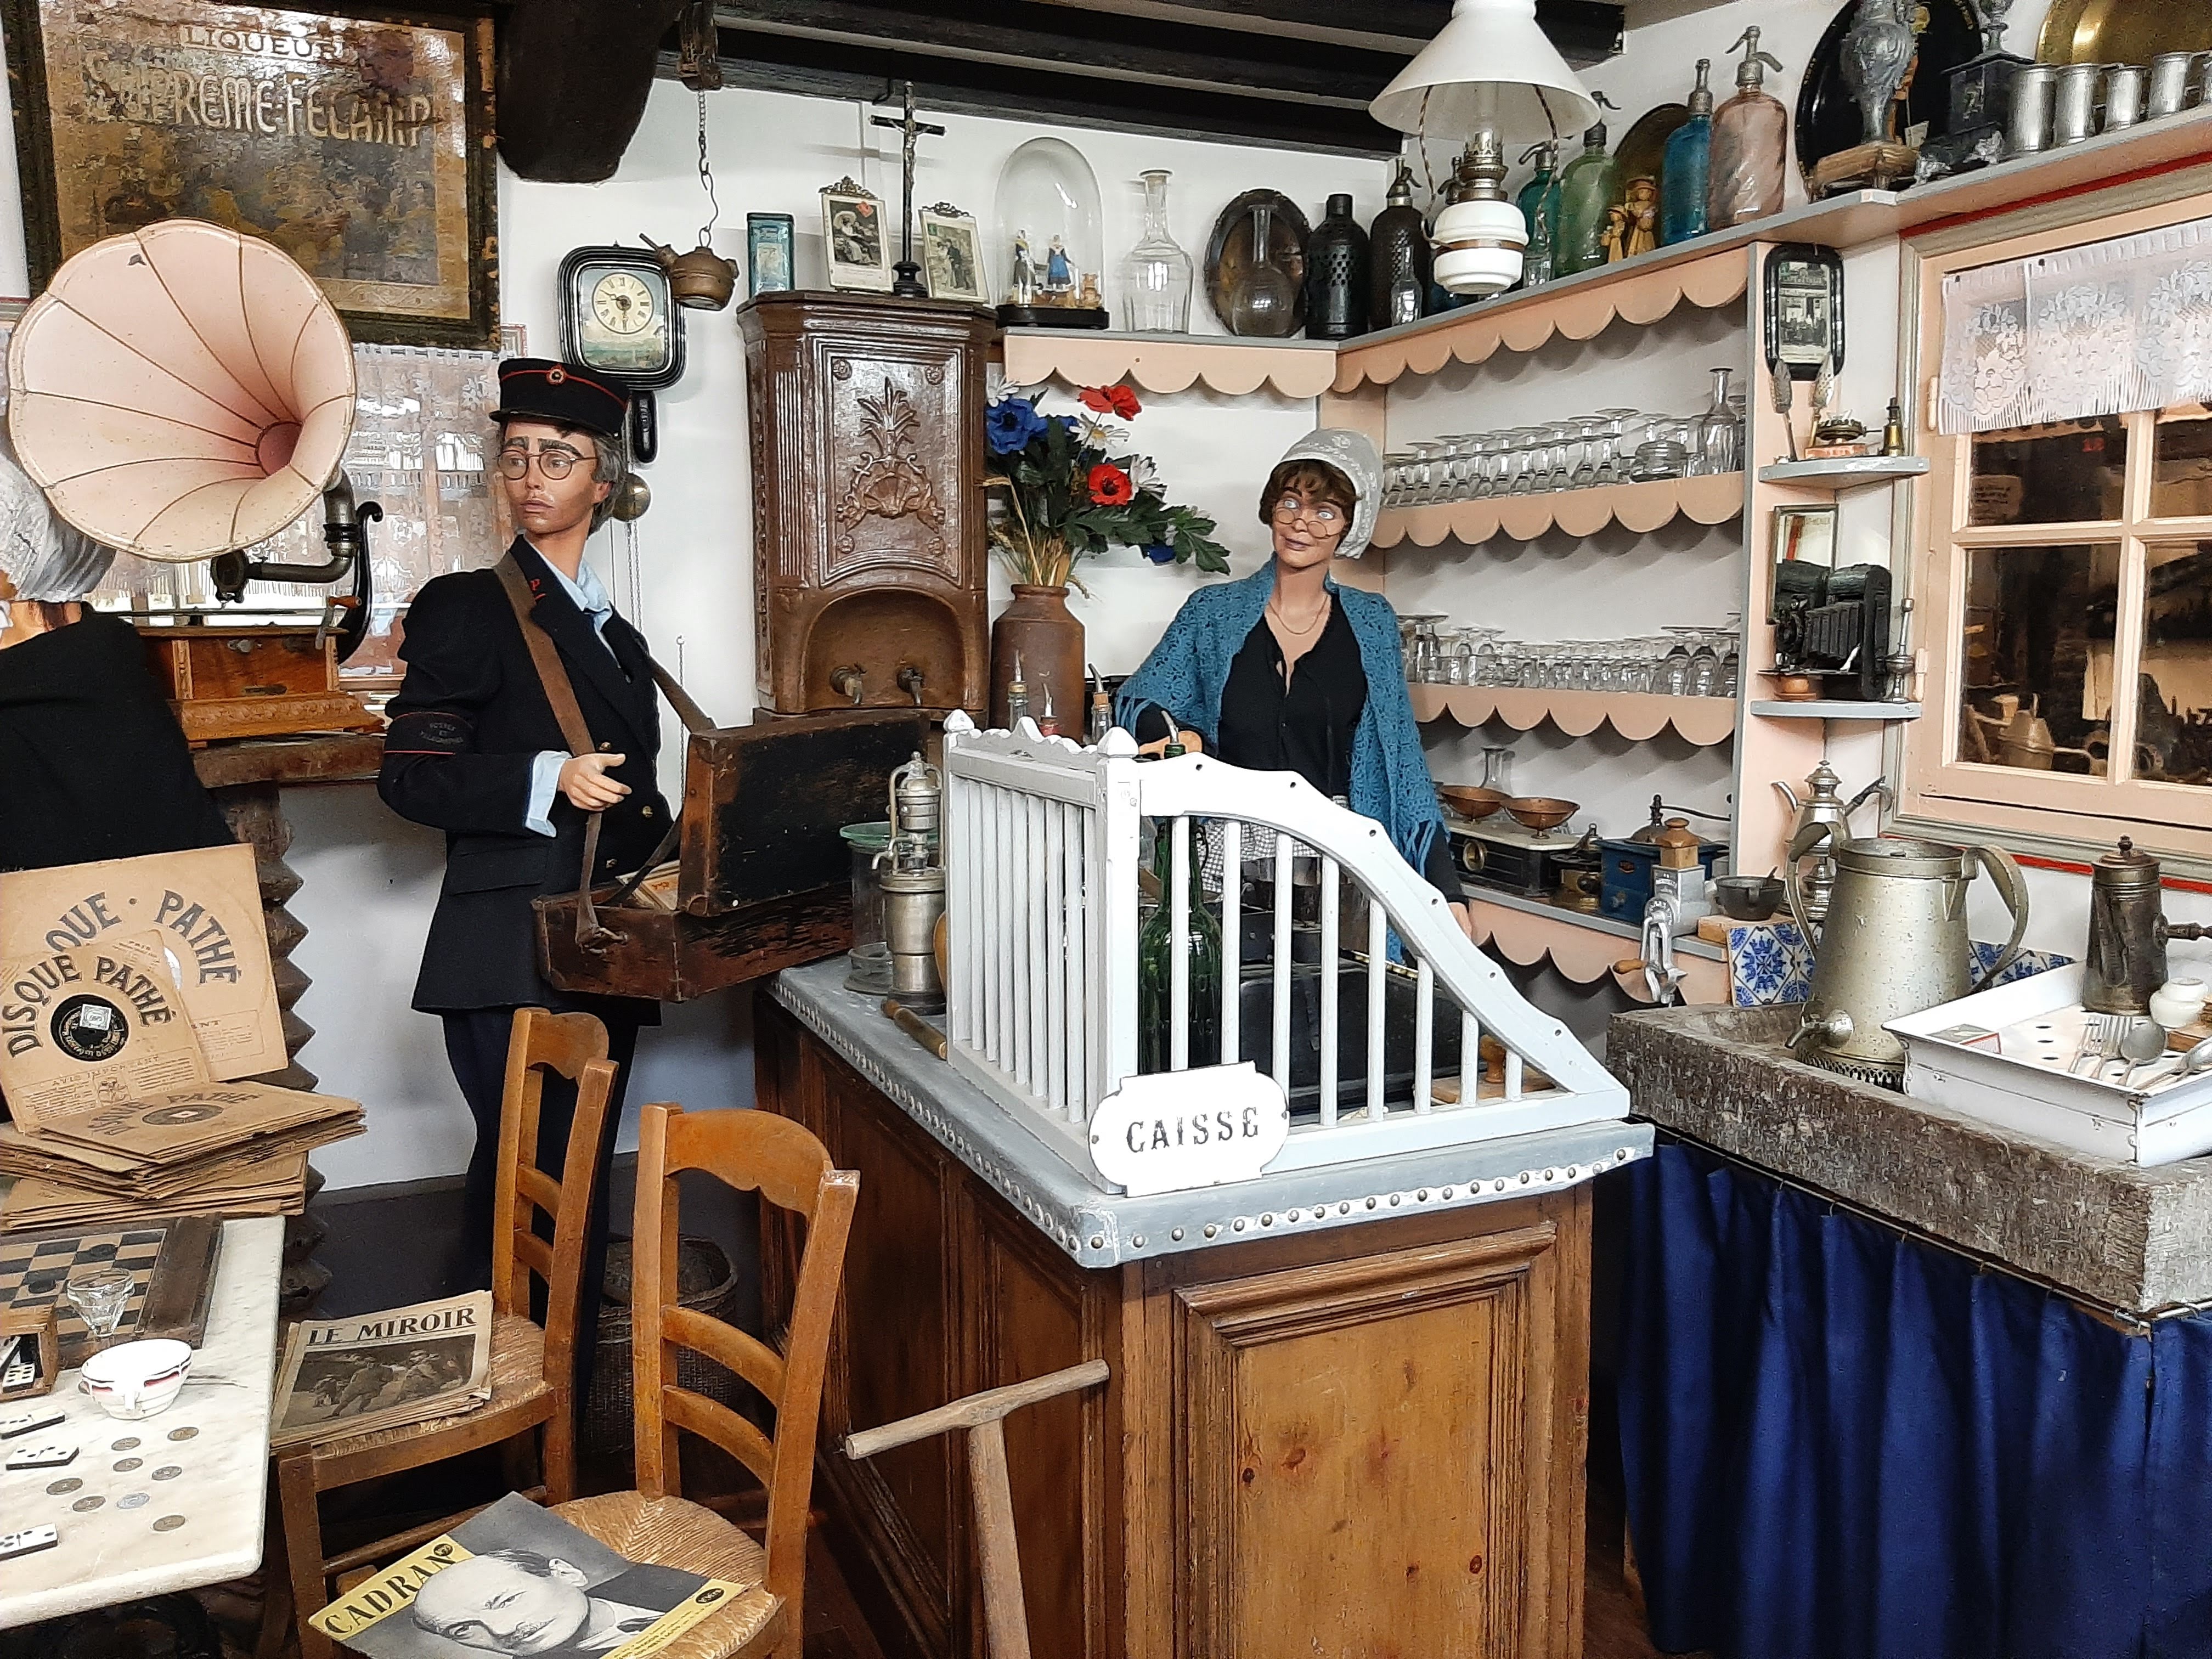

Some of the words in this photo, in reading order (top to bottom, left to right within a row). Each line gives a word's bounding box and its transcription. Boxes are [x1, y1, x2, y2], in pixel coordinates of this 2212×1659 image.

[187, 27, 340, 57] LIQUEUR
[154, 889, 242, 984] PATHÉ
[1, 955, 82, 1058] DISQUE
[94, 956, 177, 1027] PATHÉ
[1126, 1106, 1259, 1153] CAISSE
[308, 1328, 343, 1344] LE
[357, 1307, 477, 1341] MIROIR
[324, 1555, 456, 1634] CADRAN
